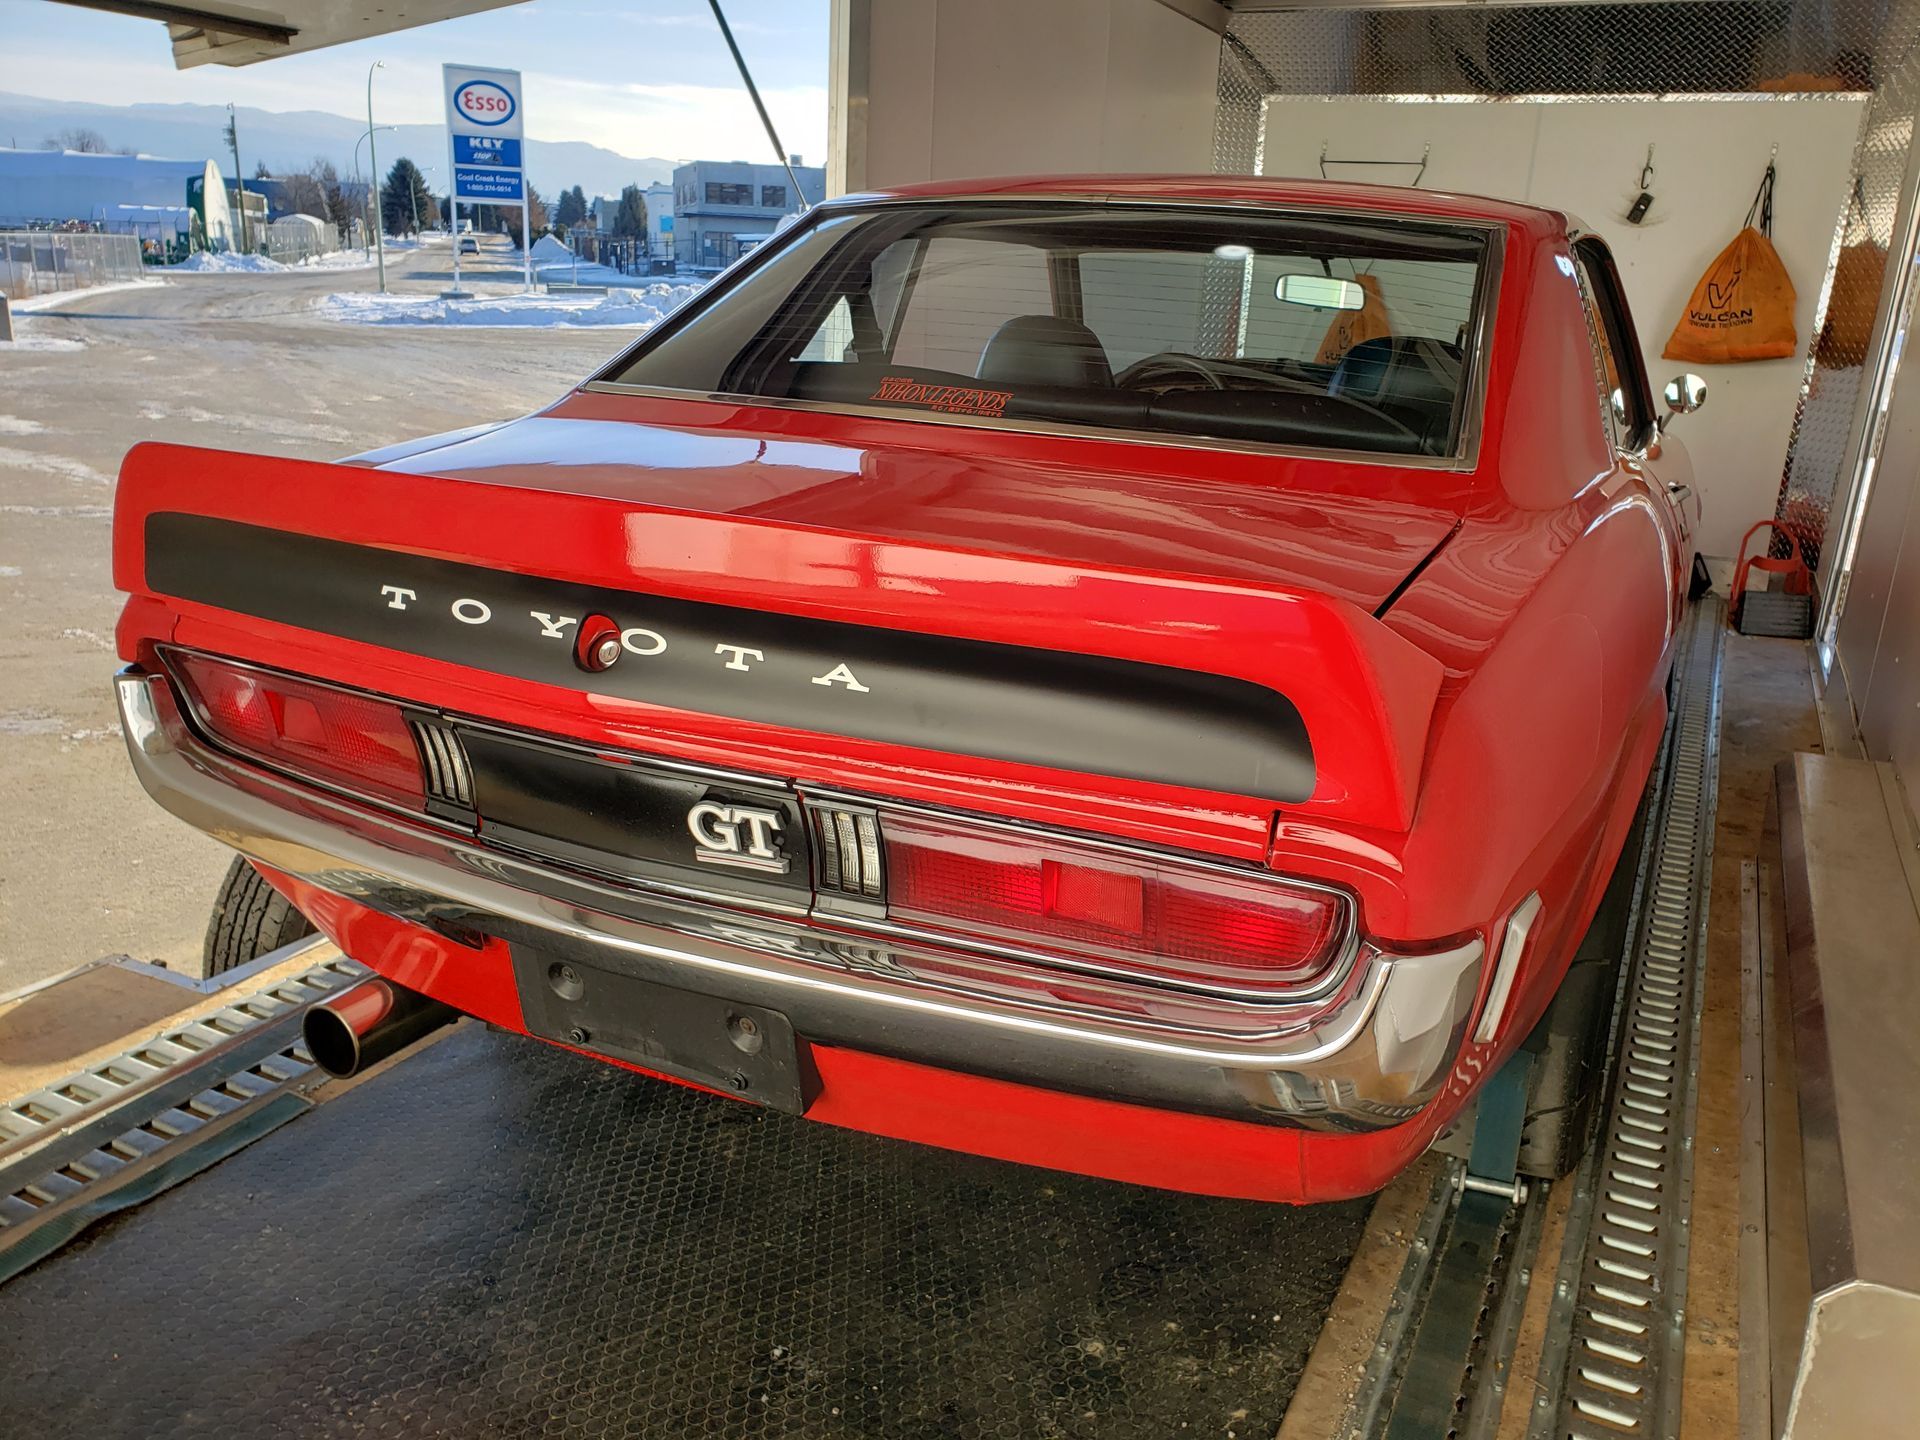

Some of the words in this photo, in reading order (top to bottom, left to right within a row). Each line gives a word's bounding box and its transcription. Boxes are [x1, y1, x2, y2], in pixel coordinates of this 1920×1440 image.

[469, 138, 503, 149] KEY
[496, 176, 519, 185] Energy
[1690, 308, 1752, 322] VULCAN
[381, 585, 870, 693] TOYOTA
[688, 802, 782, 859] GT
